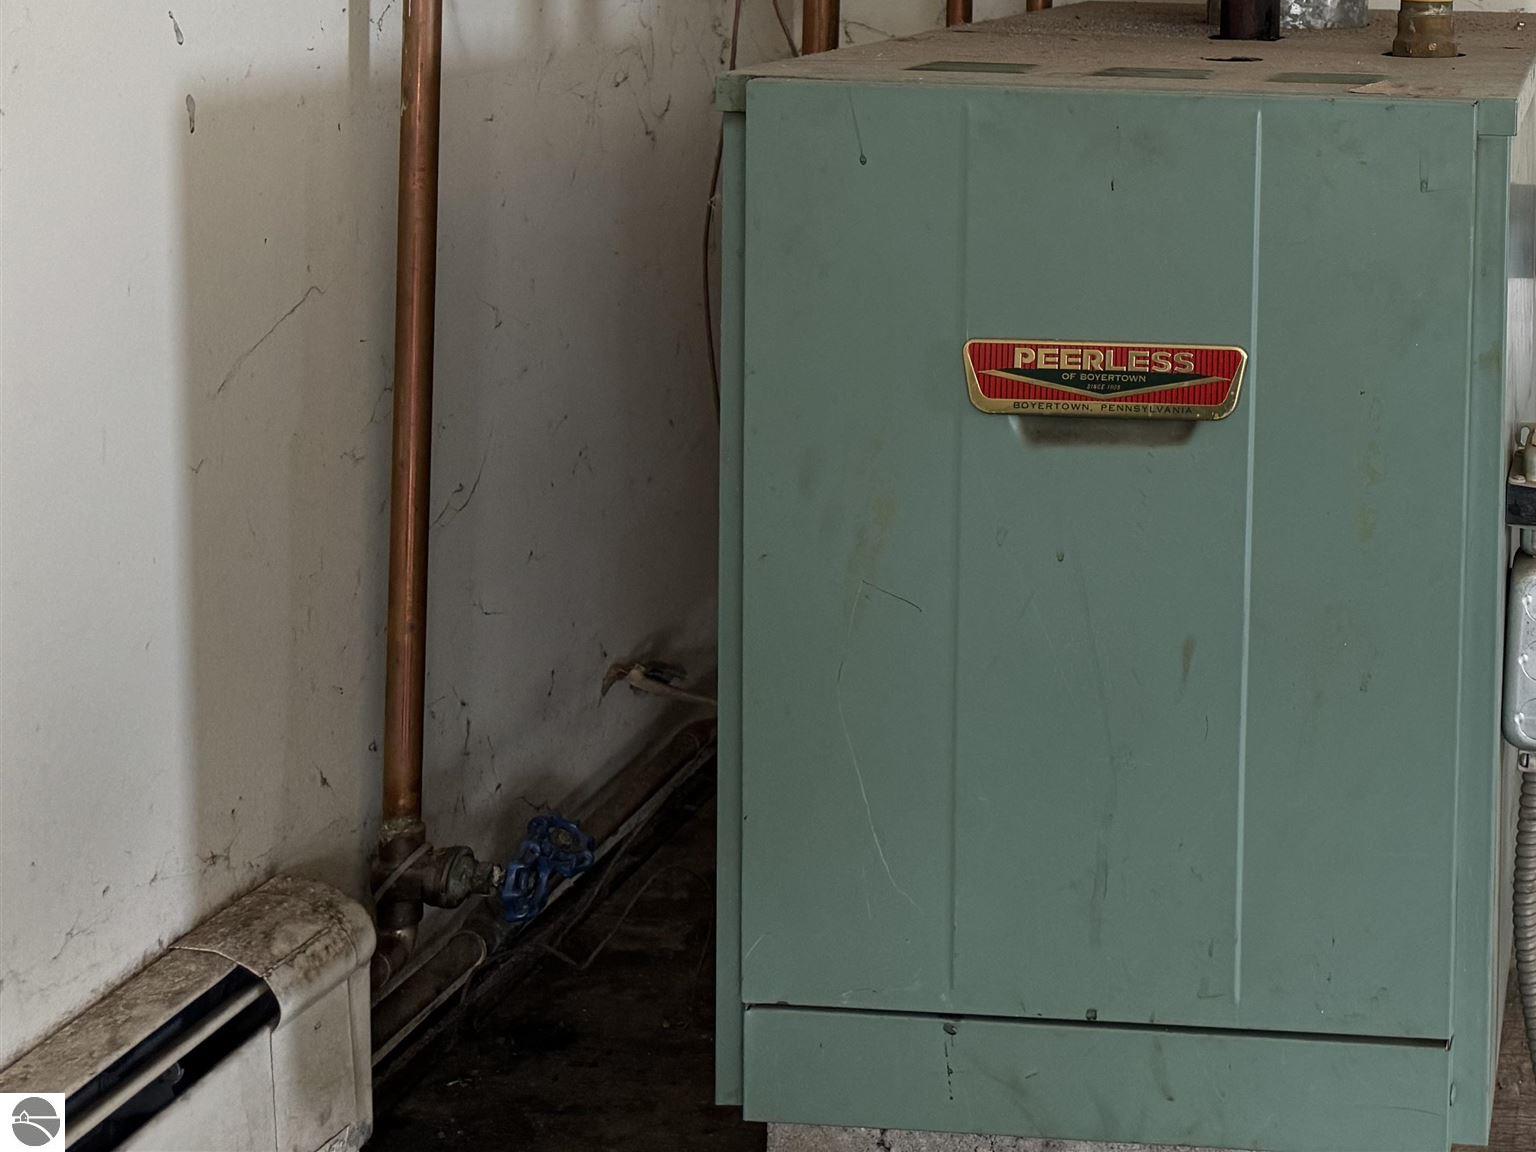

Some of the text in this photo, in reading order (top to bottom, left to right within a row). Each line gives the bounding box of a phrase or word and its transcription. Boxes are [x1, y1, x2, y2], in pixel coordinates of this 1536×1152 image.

[1013, 347, 1195, 374] PEERLESS
[1061, 372, 1147, 383] OF BOYERTOWN
[1013, 401, 1193, 415] BOYERTOWN, PENNSYLVANIA
